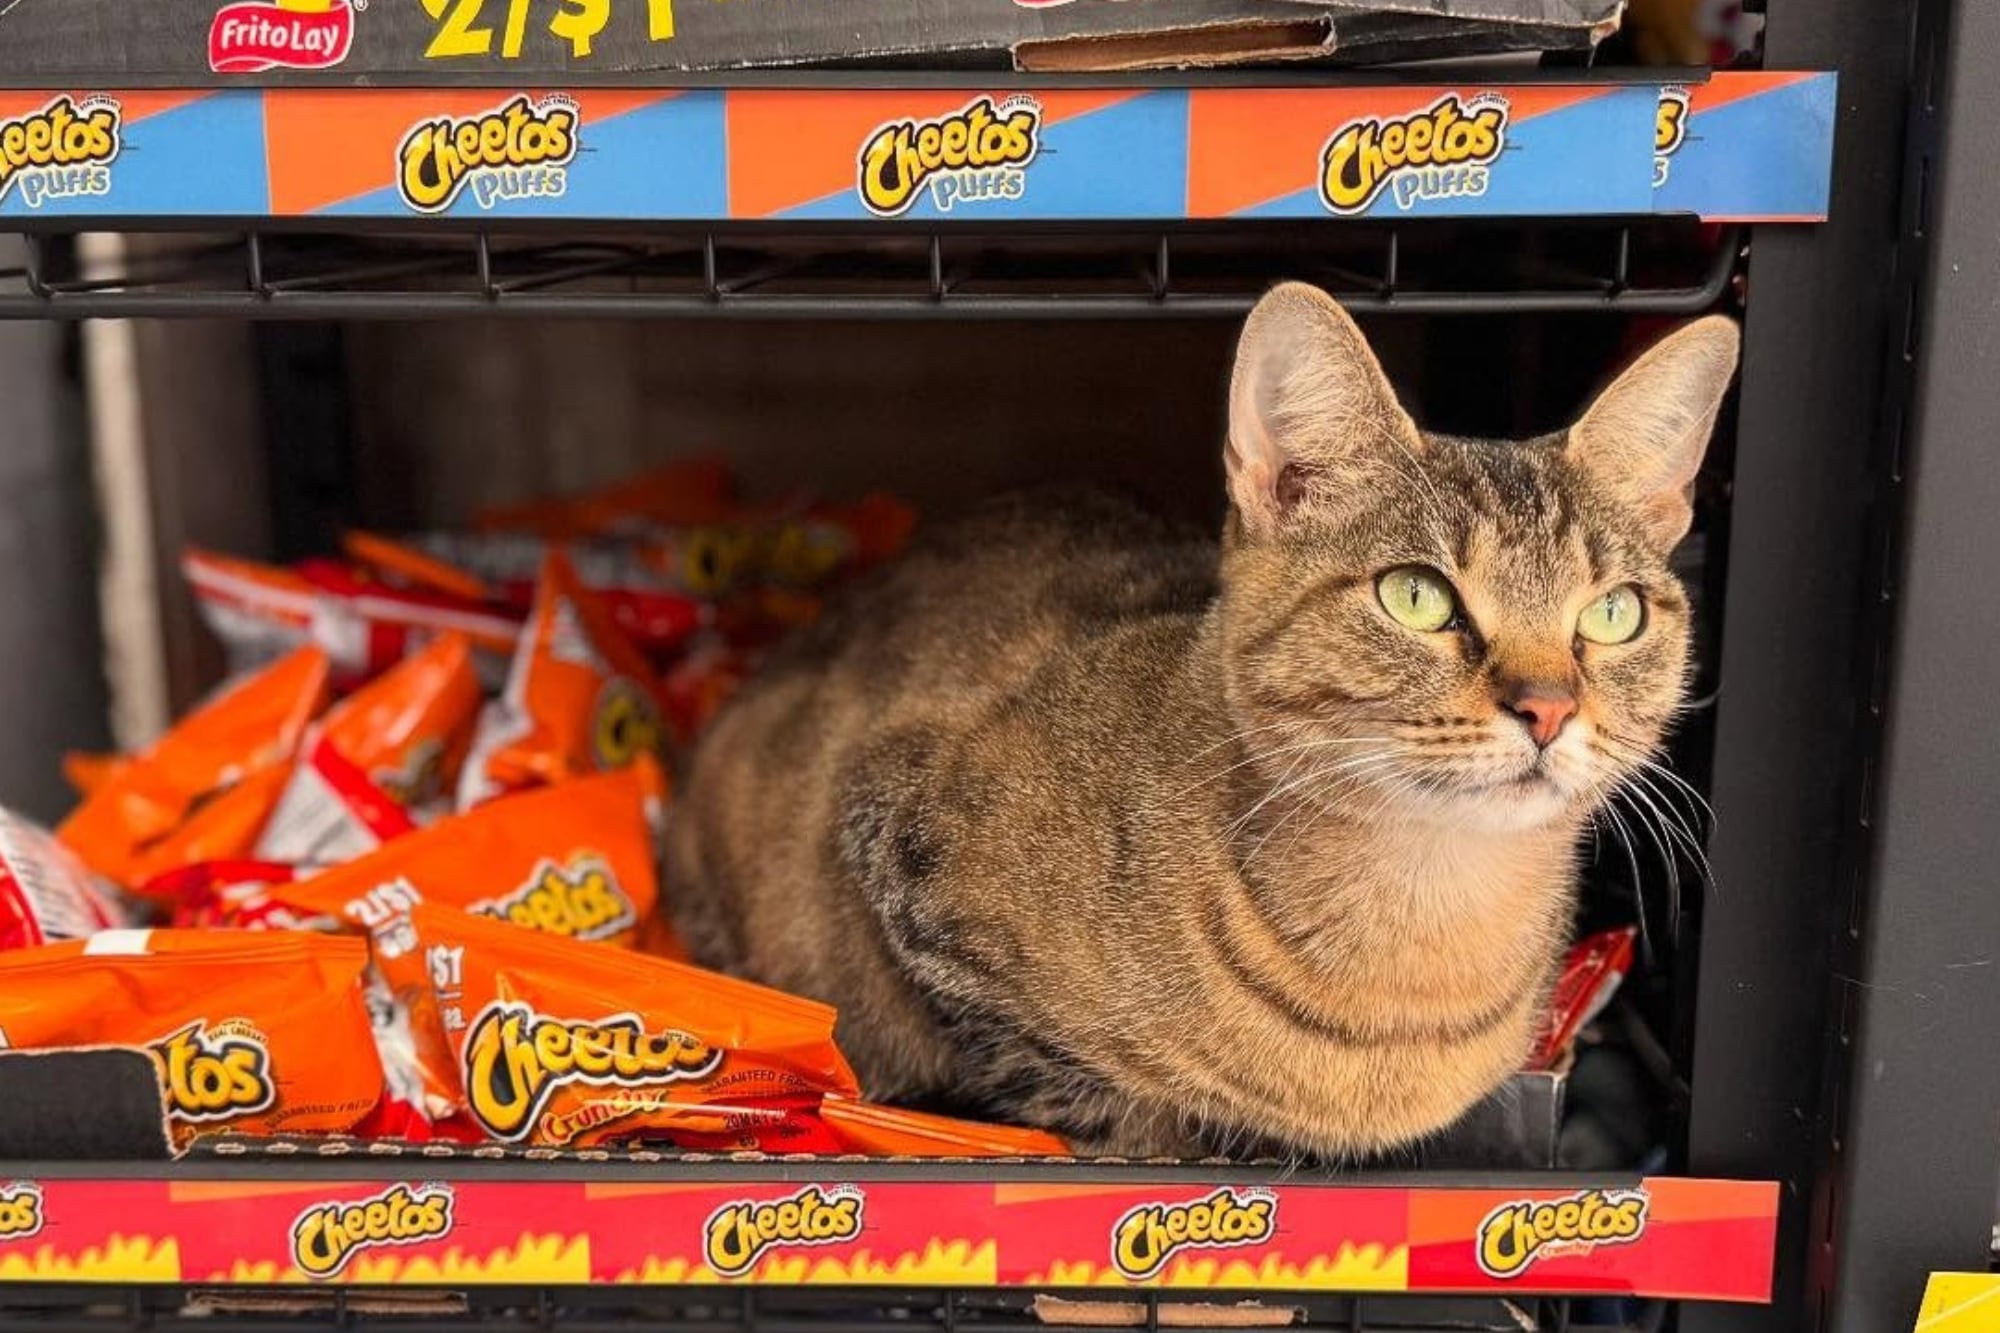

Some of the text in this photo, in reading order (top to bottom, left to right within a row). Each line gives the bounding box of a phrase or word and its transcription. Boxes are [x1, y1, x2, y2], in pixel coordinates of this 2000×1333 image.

[0, 98, 116, 180] eetos
[401, 98, 574, 208] Cheetos
[862, 99, 1036, 210] Cheetos
[1324, 97, 1504, 209] Cheetos
[295, 1187, 450, 1273] Cheetos
[708, 1188, 860, 1271] Cheetos
[1116, 1190, 1273, 1273] Cheetos
[1482, 1190, 1644, 1272] Cheetos
